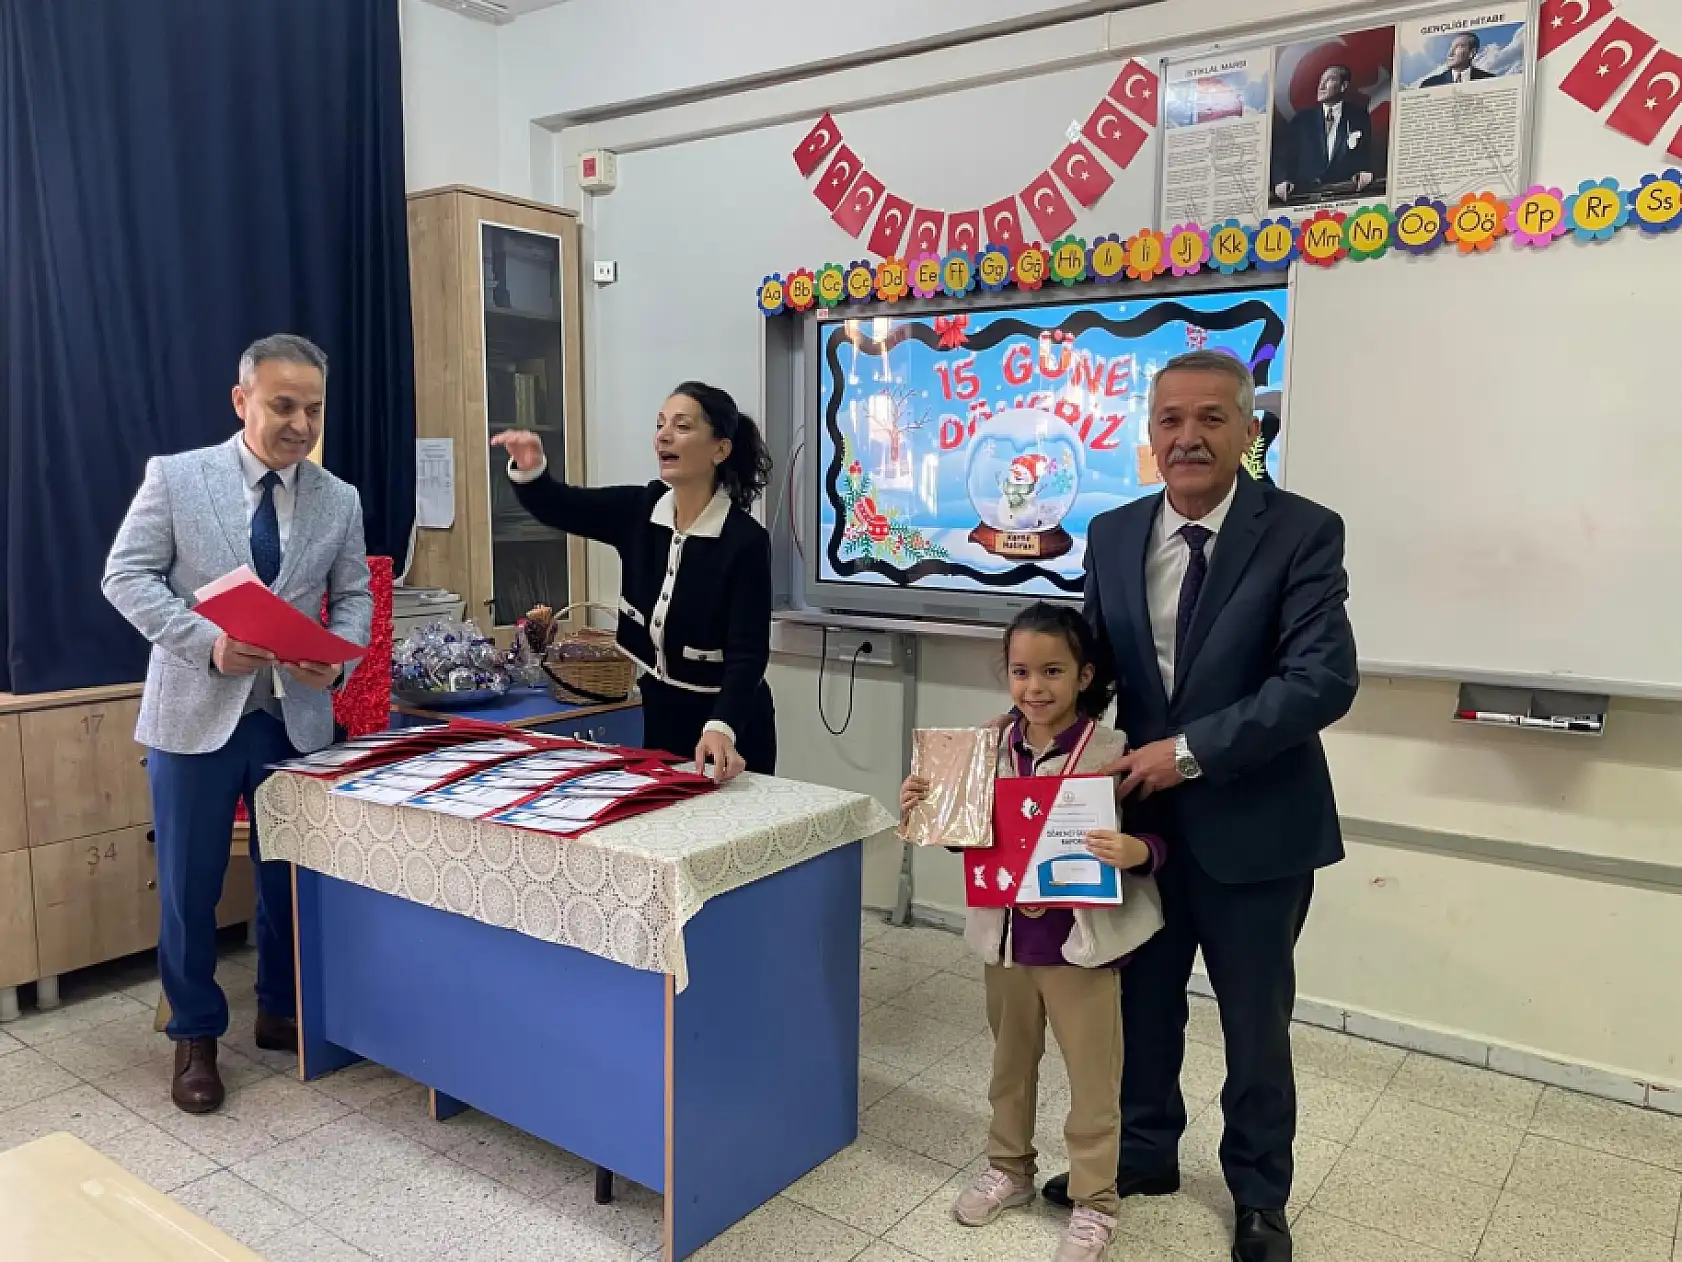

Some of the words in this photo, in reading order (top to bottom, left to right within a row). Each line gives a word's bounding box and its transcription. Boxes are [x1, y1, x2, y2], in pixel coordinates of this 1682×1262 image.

[764, 286, 781, 301] Aa
[794, 281, 811, 297] Bb
[822, 274, 841, 292] Cc
[883, 270, 903, 287] Dd
[920, 264, 938, 282] Ee
[949, 262, 965, 288] Ff
[983, 257, 1004, 282] Gg
[1057, 249, 1081, 269] Hh
[1177, 235, 1192, 264] Jj
[1219, 233, 1243, 255] Kk
[1263, 231, 1282, 253] Ll
[1307, 226, 1341, 249] Mm
[1353, 219, 1383, 242] Nn
[1401, 212, 1437, 235] Oo
[1457, 205, 1495, 233] Öö
[1524, 201, 1554, 233] Pp
[1585, 196, 1613, 220] Rr
[1646, 188, 1674, 211] Ss
[934, 355, 981, 400] 15
[80, 713, 105, 735] 17
[86, 841, 117, 866] 34
